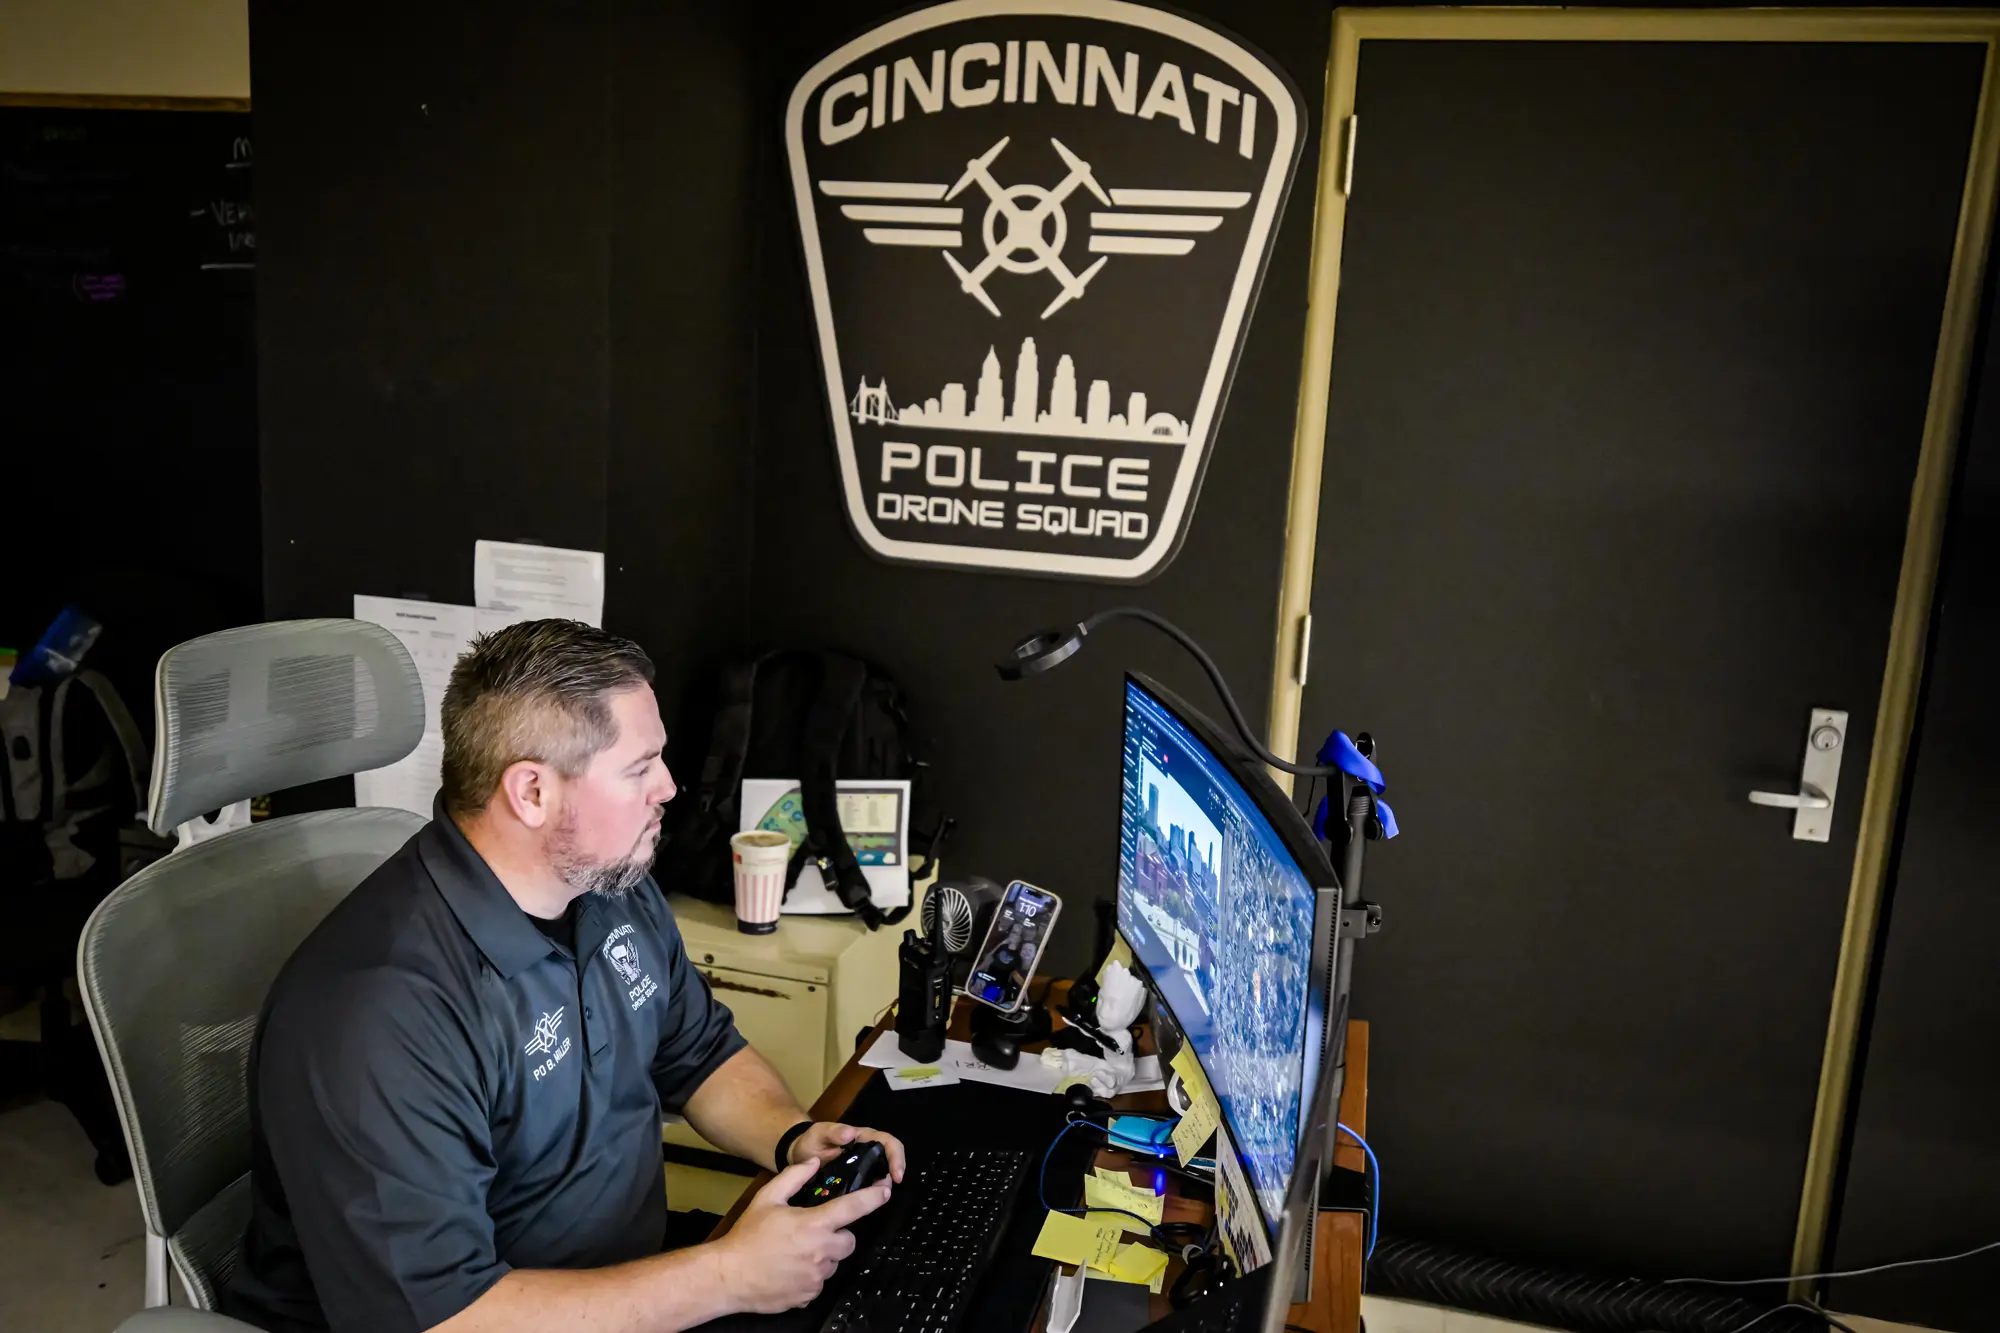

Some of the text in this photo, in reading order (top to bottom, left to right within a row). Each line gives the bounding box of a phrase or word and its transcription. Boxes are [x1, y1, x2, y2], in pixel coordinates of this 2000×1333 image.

[819, 40, 1258, 160] CINCINNATI
[880, 441, 1150, 501] POLICE
[876, 492, 1149, 540] DRONE SQUAD
[602, 924, 635, 959] CINCINNATI
[628, 974, 652, 1002] POLICE
[631, 982, 658, 1011] DRONE SQUAD
[533, 1037, 572, 1081] PO B. MILLER
